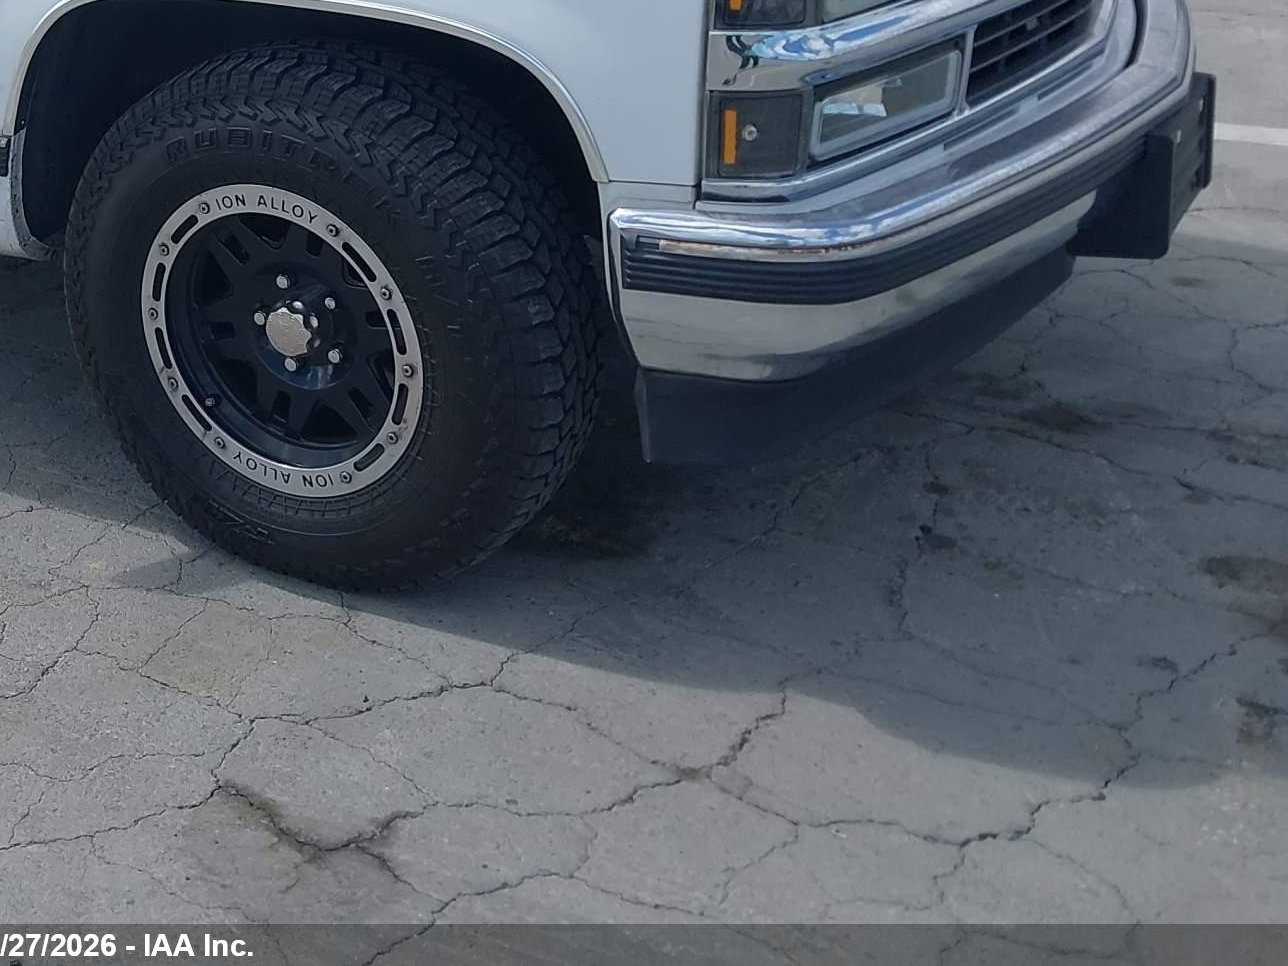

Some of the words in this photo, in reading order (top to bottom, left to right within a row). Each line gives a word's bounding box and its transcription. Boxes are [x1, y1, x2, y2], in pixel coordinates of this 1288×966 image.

[216, 194, 248, 211] ION
[257, 194, 319, 225] ALLOY
[233, 451, 291, 484] ALLOY
[302, 474, 335, 489] ION
